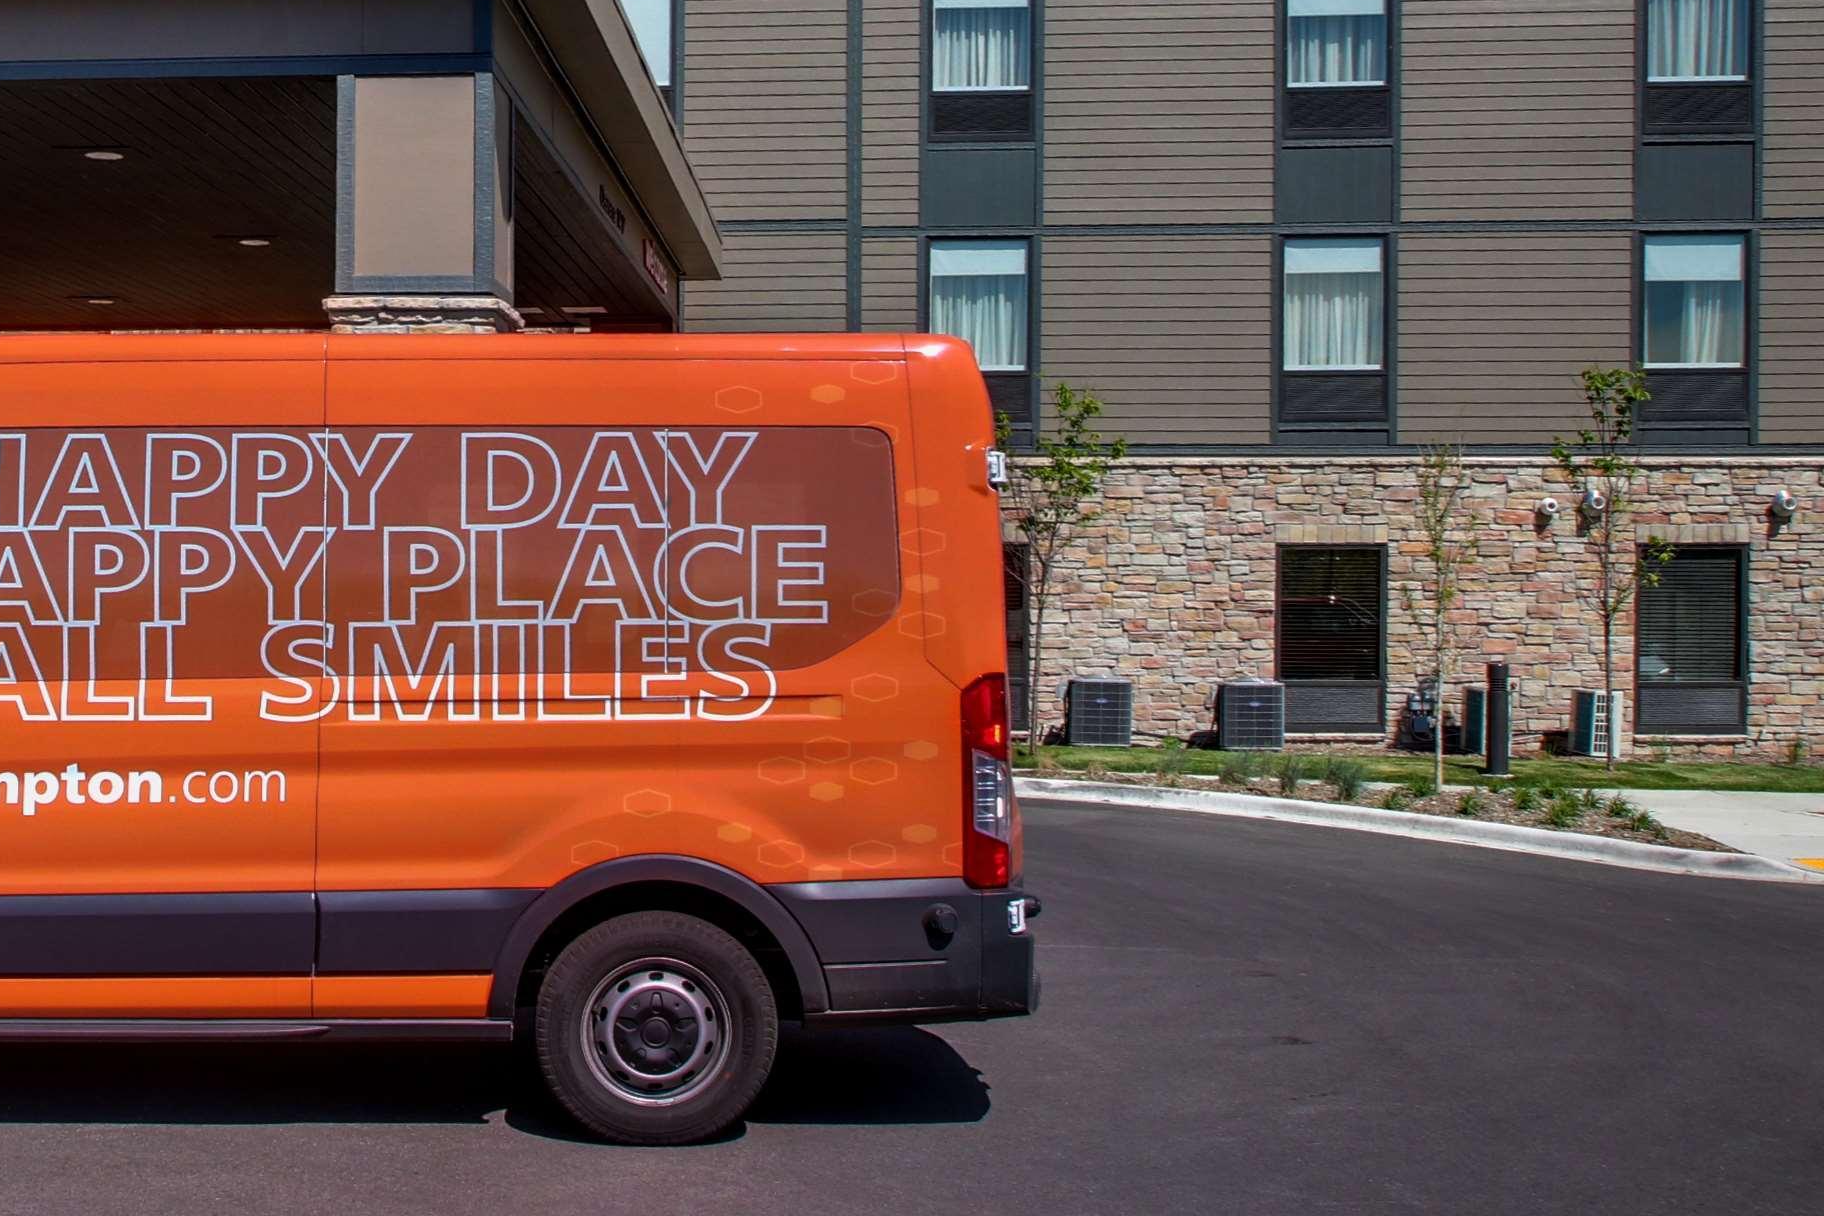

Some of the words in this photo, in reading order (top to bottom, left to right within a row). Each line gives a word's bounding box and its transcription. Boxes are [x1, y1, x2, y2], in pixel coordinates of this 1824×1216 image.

[459, 431, 759, 530] DAY
[382, 524, 830, 624] PLACE
[259, 619, 777, 722] SMILES
